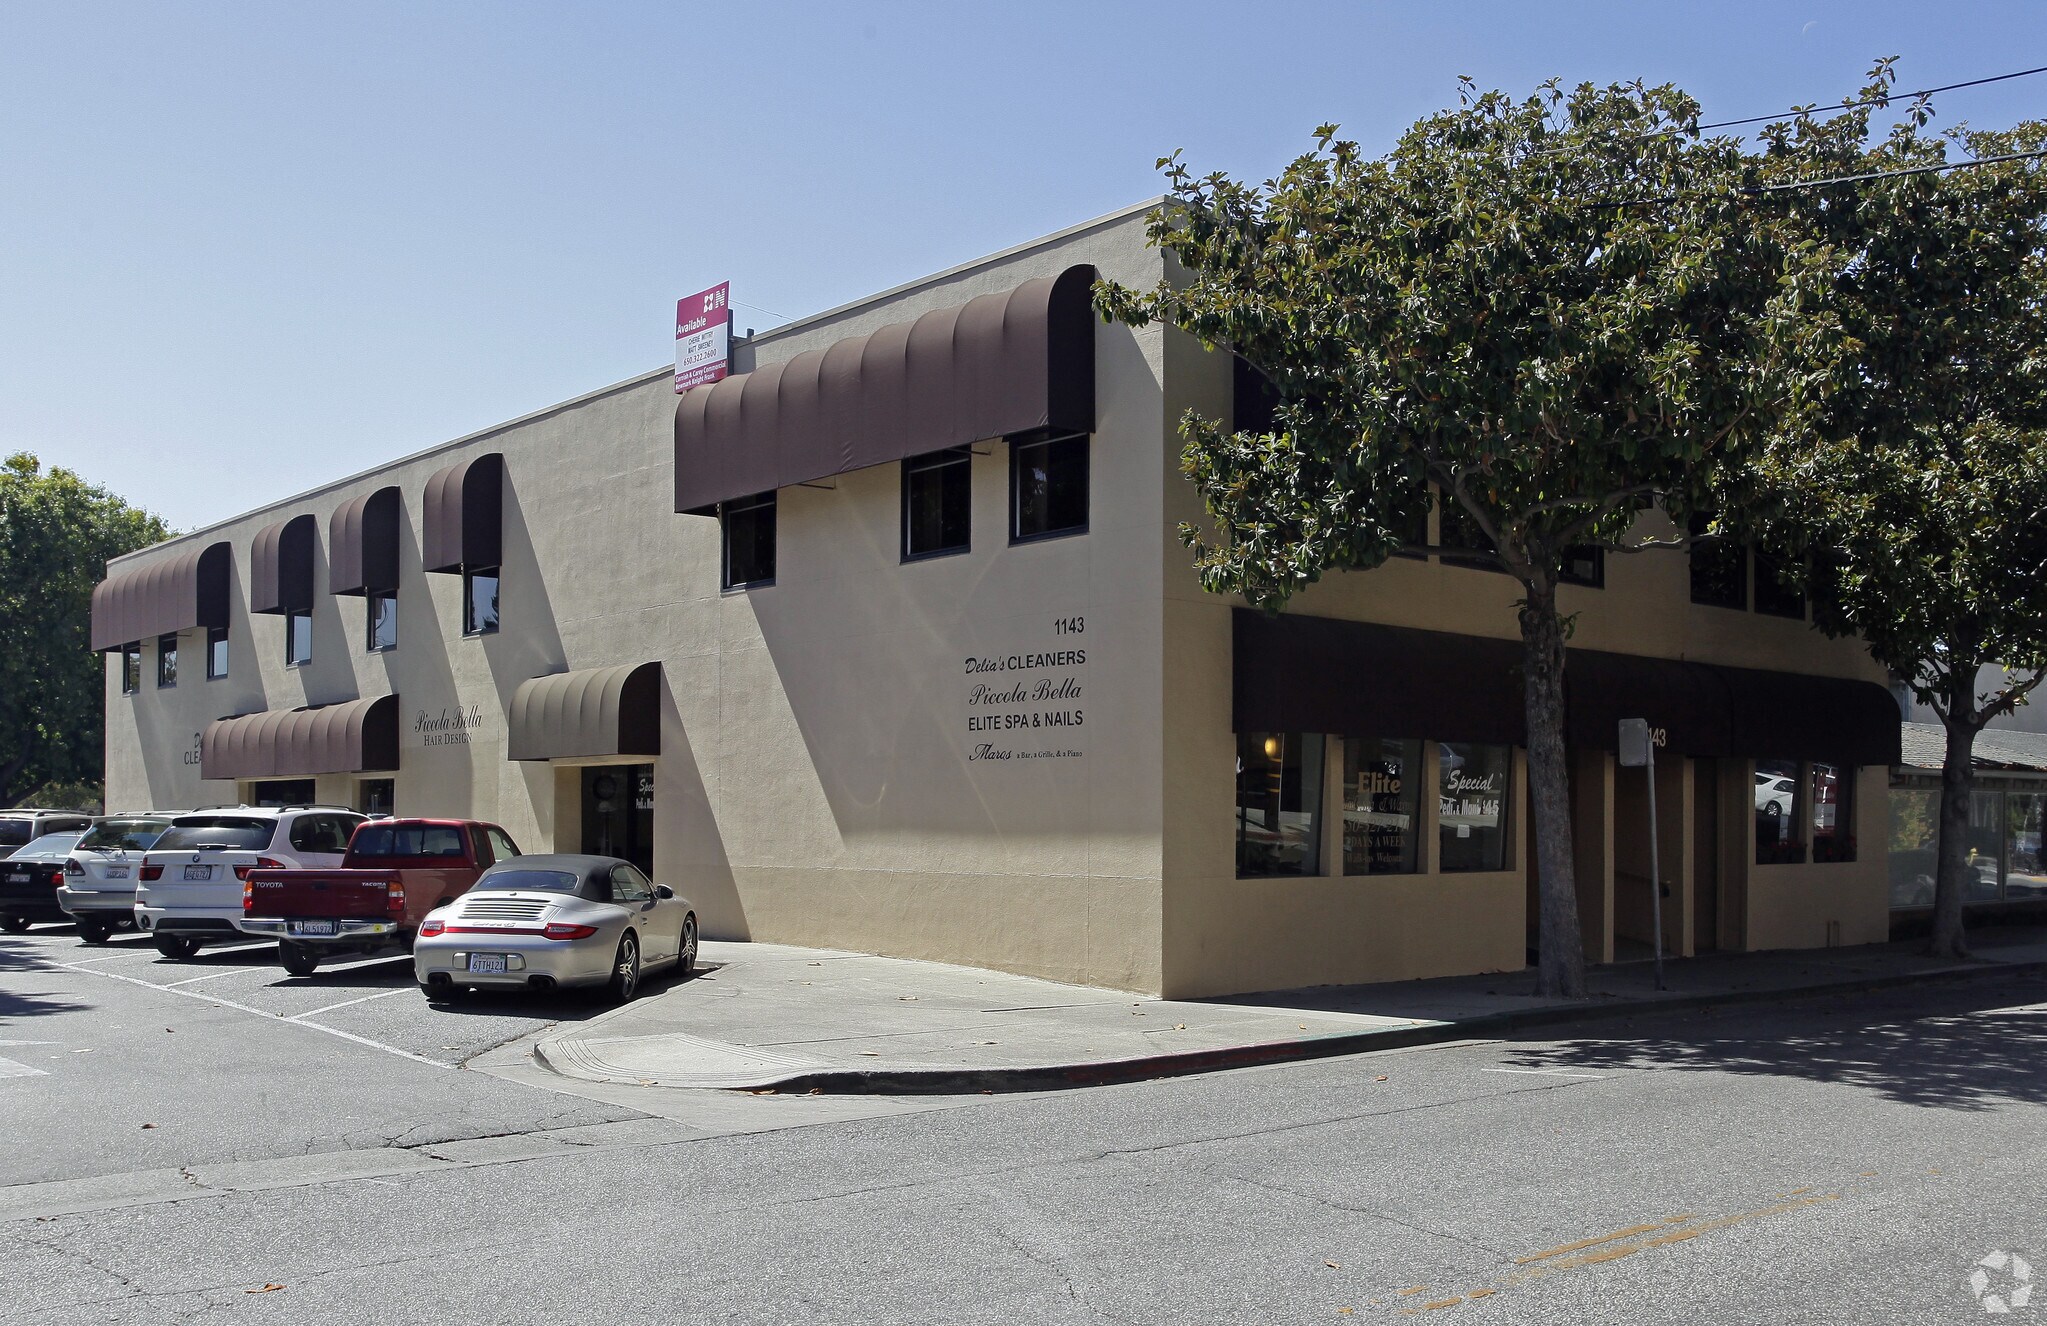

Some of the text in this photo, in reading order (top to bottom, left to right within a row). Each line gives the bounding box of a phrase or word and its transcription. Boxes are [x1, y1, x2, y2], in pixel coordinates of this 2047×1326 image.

[677, 316, 706, 335] Available
[691, 376, 704, 386] Knight
[1054, 616, 1085, 635] 1143
[965, 649, 1086, 674] Delia's CLEANERS
[968, 677, 1082, 706] Piccola Bella
[414, 705, 482, 733] Piccola Bella
[968, 710, 1083, 731] ELITE SPA & NAILS
[424, 732, 473, 747] HAIR DESIGN
[1648, 727, 1666, 747] 143
[1055, 750, 1061, 758] &
[1066, 749, 1083, 757] Piano
[1357, 771, 1401, 794] Elite
[1447, 769, 1494, 795] Special
[1351, 836, 1374, 848] DAYS
[1375, 836, 1381, 848] A
[1382, 836, 1407, 848] WEEK
[255, 881, 284, 889] TOYOTA
[473, 960, 503, 971] 6TTH121
